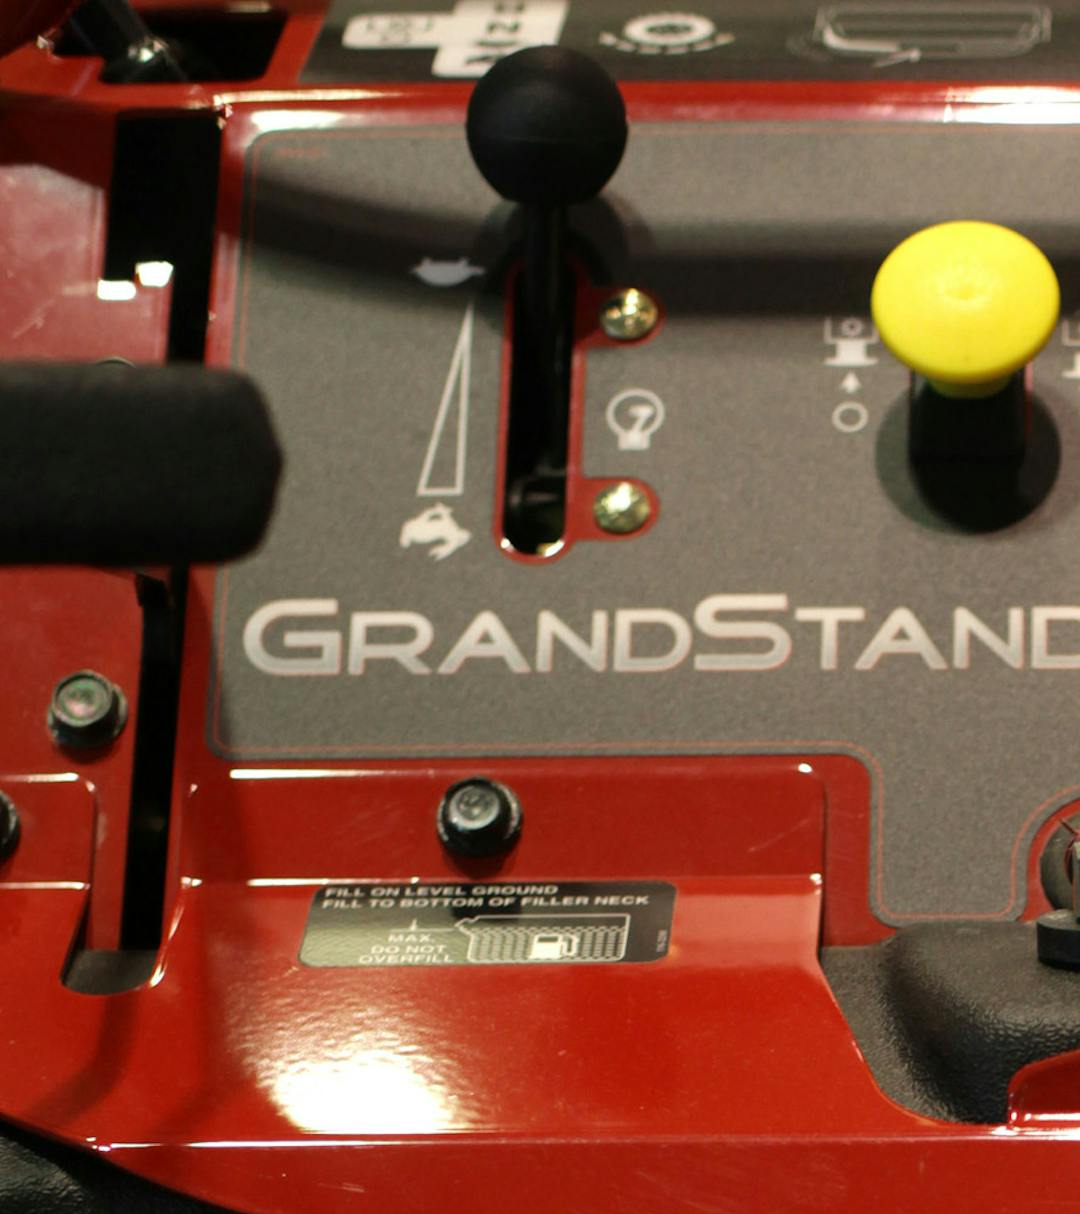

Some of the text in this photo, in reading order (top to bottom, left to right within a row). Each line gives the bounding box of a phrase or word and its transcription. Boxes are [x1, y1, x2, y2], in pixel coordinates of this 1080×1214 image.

[325, 885, 559, 898] FILL ON LEVEL GROUND
[322, 895, 650, 909] FILL TO BOTTOM OF FILLER NECK
[371, 944, 448, 954] DO NOT
[359, 954, 455, 964] OVERFILL
